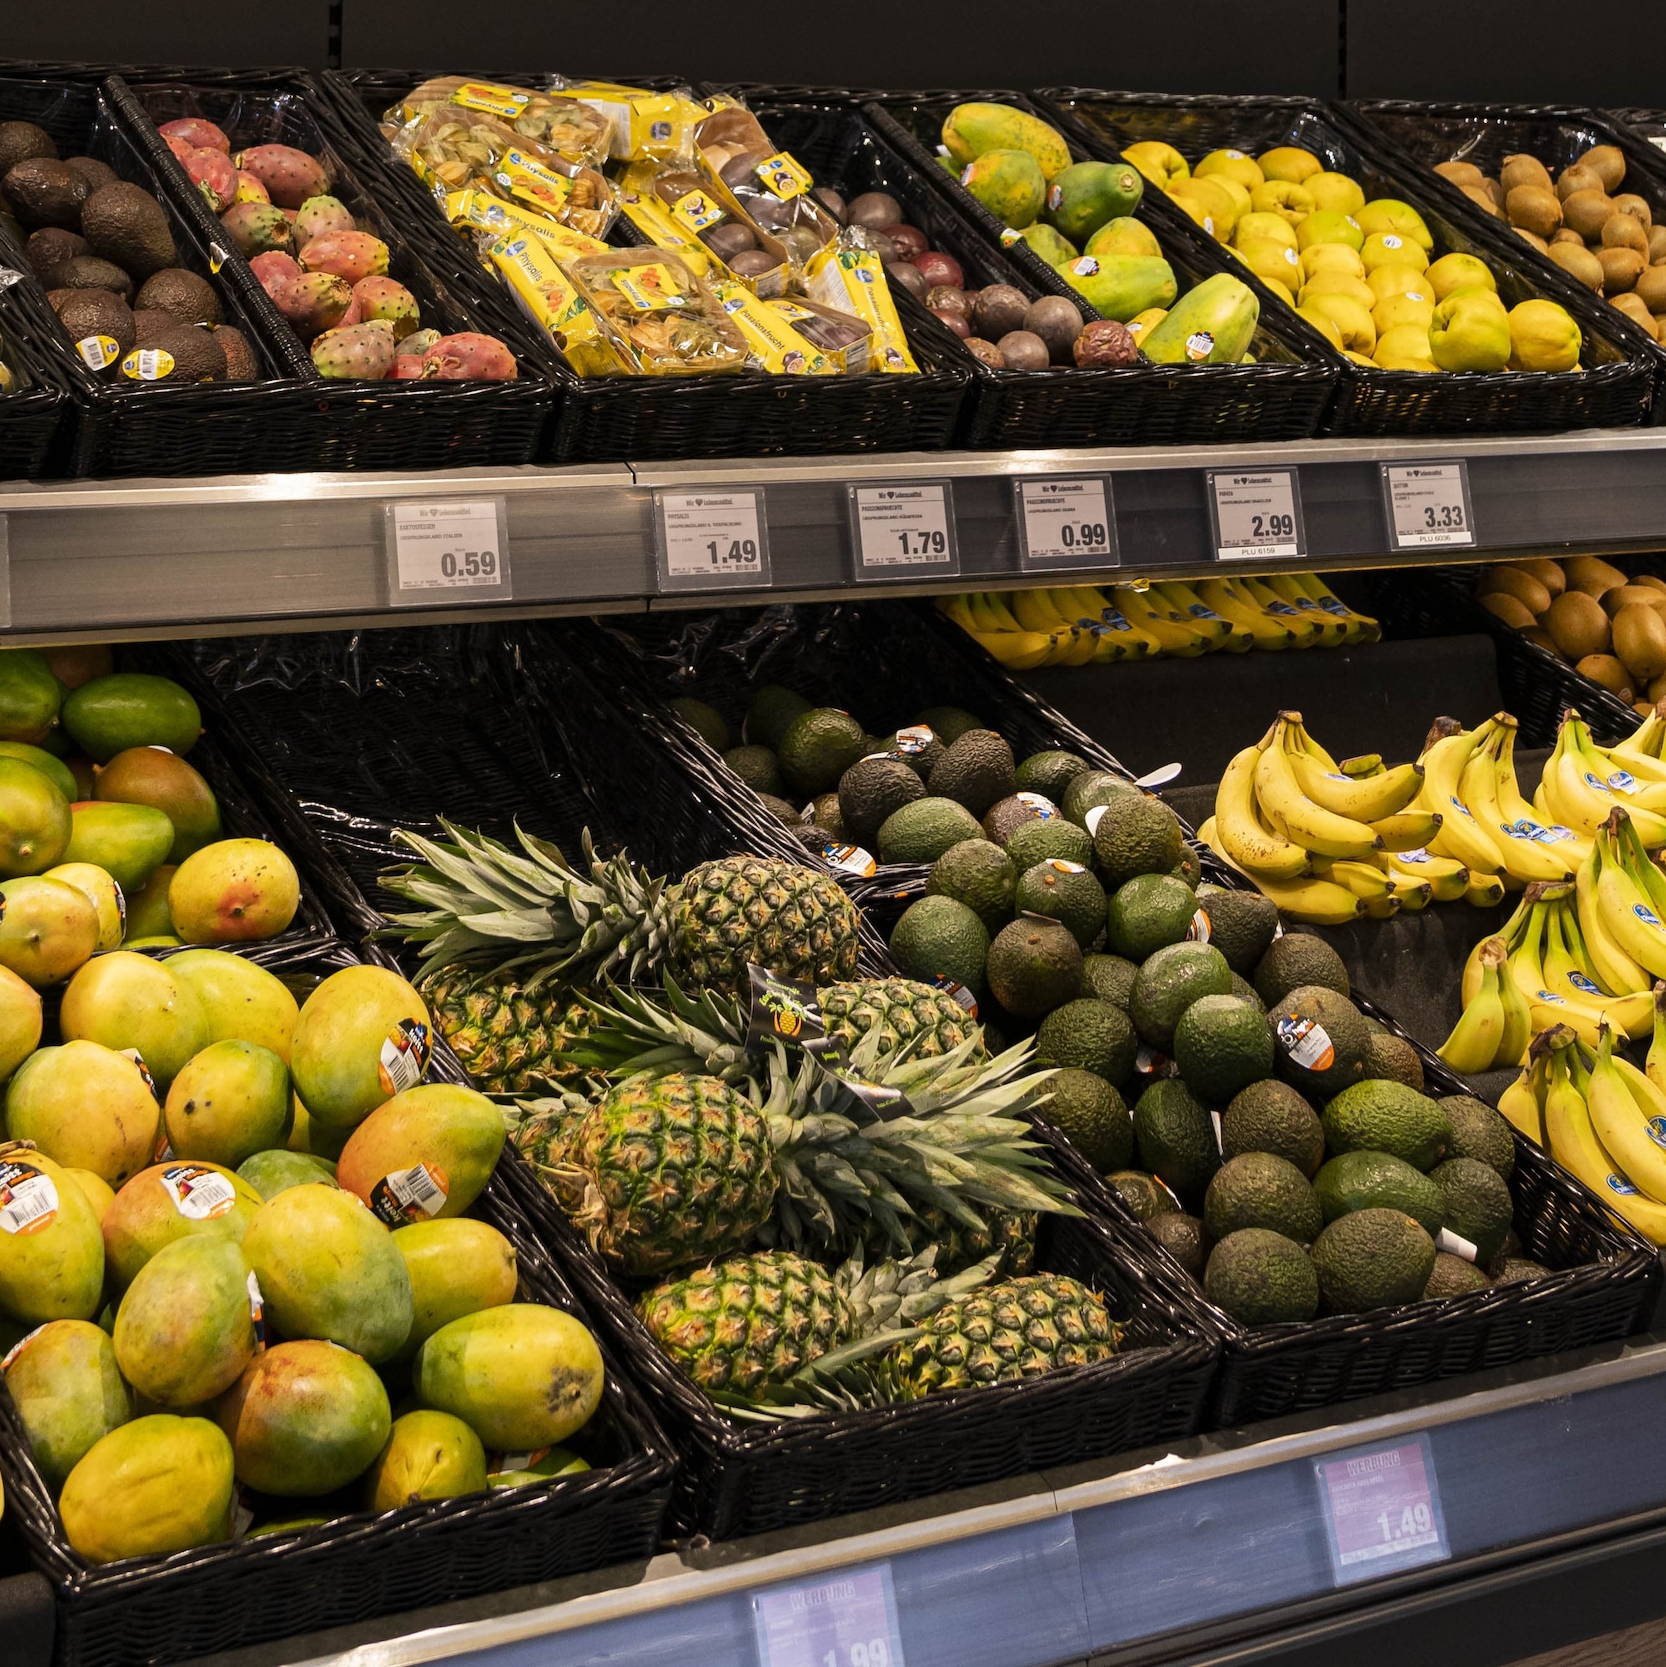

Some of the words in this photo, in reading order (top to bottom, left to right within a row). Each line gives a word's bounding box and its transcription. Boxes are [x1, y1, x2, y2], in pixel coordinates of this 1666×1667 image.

[522, 160, 559, 185] Physalis
[520, 252, 543, 282] Physalis
[741, 309, 785, 350] Passionsfrucht
[1251, 514, 1293, 537] 2.99
[1424, 506, 1463, 527] 3.33
[898, 531, 945, 554] 1.79
[1061, 524, 1106, 547] 0.99
[441, 551, 496, 577] 0.59
[706, 540, 757, 564] 1.49
[1346, 1449, 1400, 1477] WERBUNG
[1377, 1502, 1431, 1542] 1.49
[789, 1581, 855, 1610] WERBUNG
